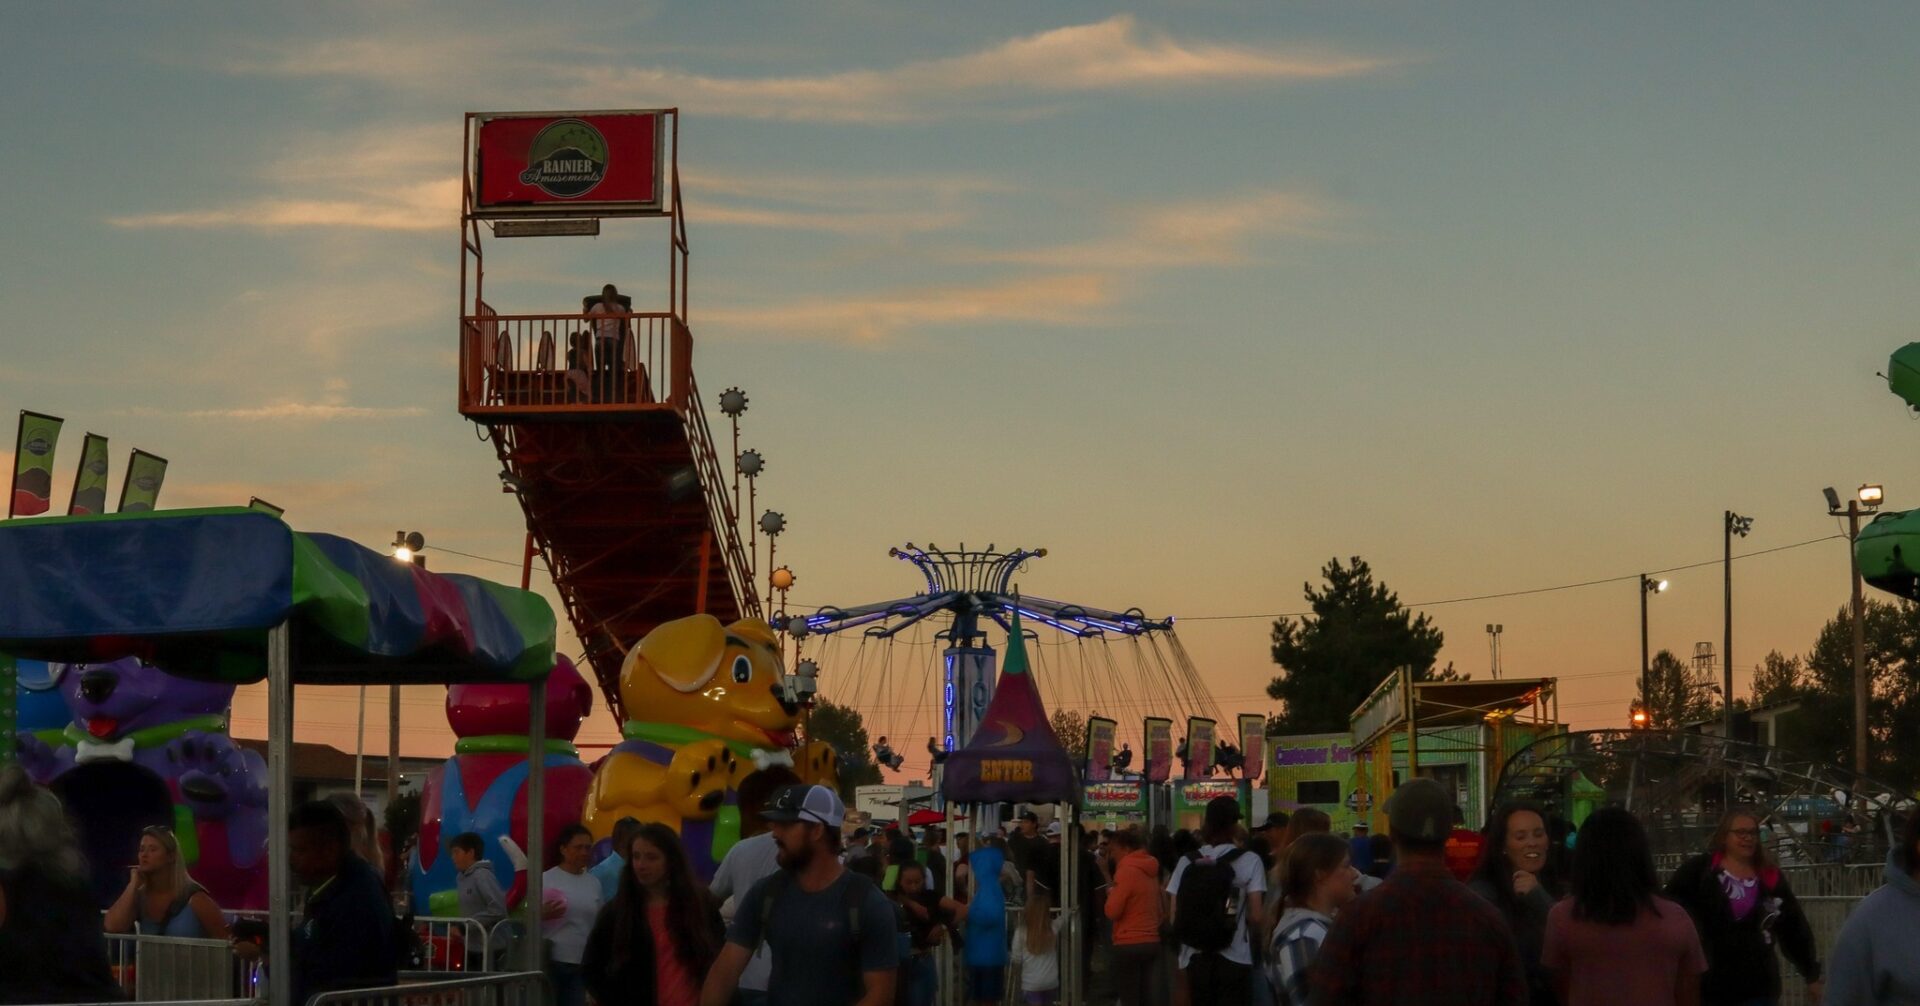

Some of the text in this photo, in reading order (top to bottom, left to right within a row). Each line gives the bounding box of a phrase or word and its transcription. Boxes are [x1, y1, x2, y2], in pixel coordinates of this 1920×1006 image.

[523, 168, 600, 182] Amusements
[543, 159, 592, 173] RAINIER
[973, 656, 987, 721] YOY
[981, 759, 1033, 782] ENTER
